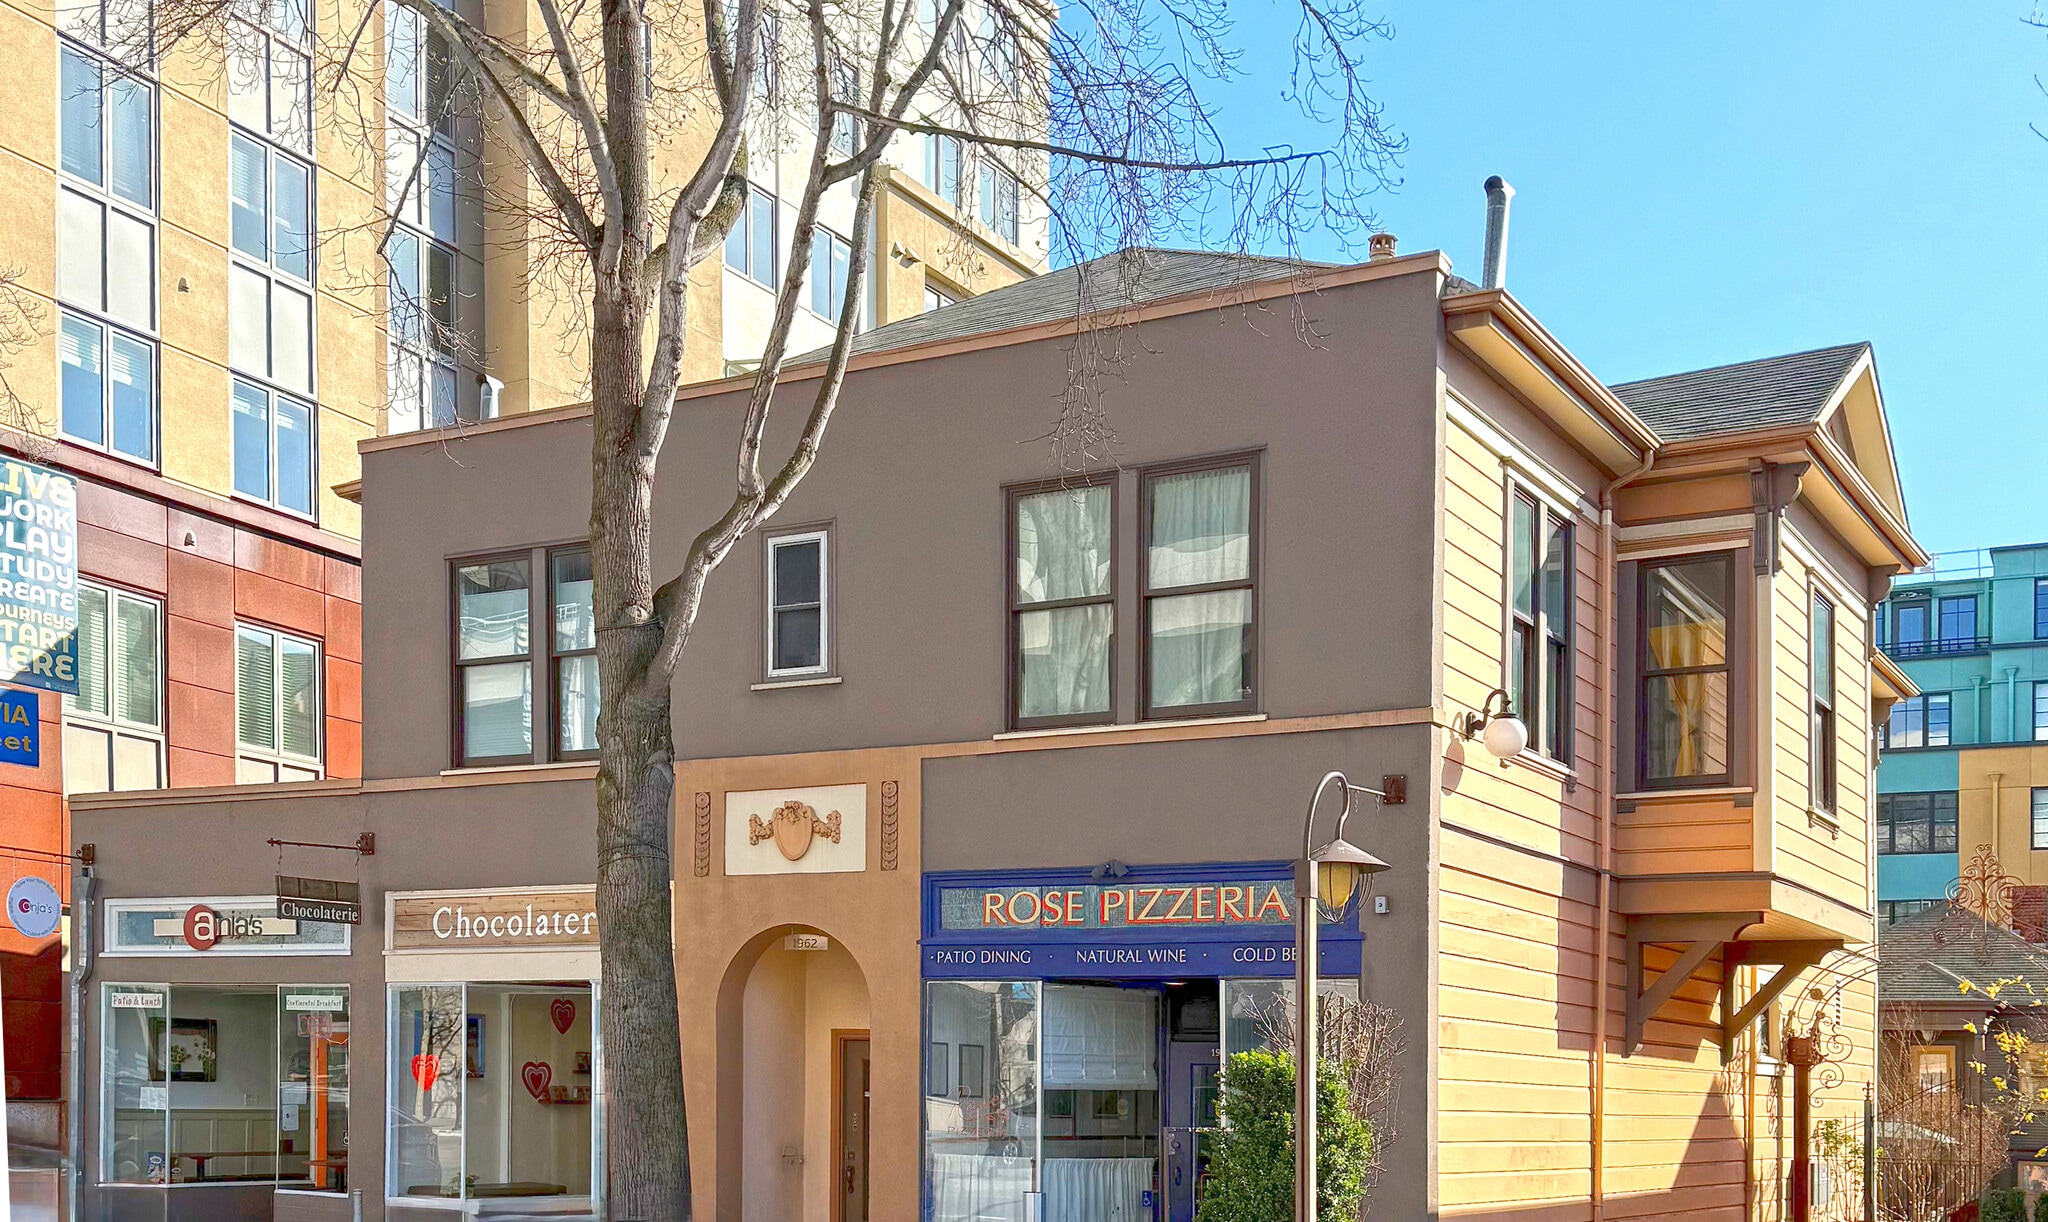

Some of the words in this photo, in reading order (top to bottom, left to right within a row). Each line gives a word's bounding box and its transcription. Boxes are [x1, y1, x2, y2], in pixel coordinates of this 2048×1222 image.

[0, 461, 76, 508] IVE
[0, 520, 73, 565] LAY
[0, 552, 73, 589] TUDY
[0, 578, 75, 611] REATE
[0, 619, 75, 653] TART
[0, 701, 30, 727] IA
[0, 735, 32, 753] et
[281, 901, 359, 922] Chocolaterie
[983, 890, 1085, 926] ROSE
[1100, 885, 1292, 925] PIZZERIA
[193, 910, 263, 941] anja's
[432, 904, 597, 939] Chocolater
[793, 938, 818, 949] 1962
[937, 950, 976, 964] PATIO
[980, 950, 1031, 964] DINING
[1076, 949, 1143, 963] NATURAL
[1147, 948, 1187, 963] WINE
[1233, 947, 1276, 962] COLD
[1282, 947, 1297, 961] BE
[113, 995, 132, 1006] Patio
[133, 996, 139, 1006] &
[141, 995, 161, 1007] Lunch
[1210, 1048, 1221, 1057] 19
